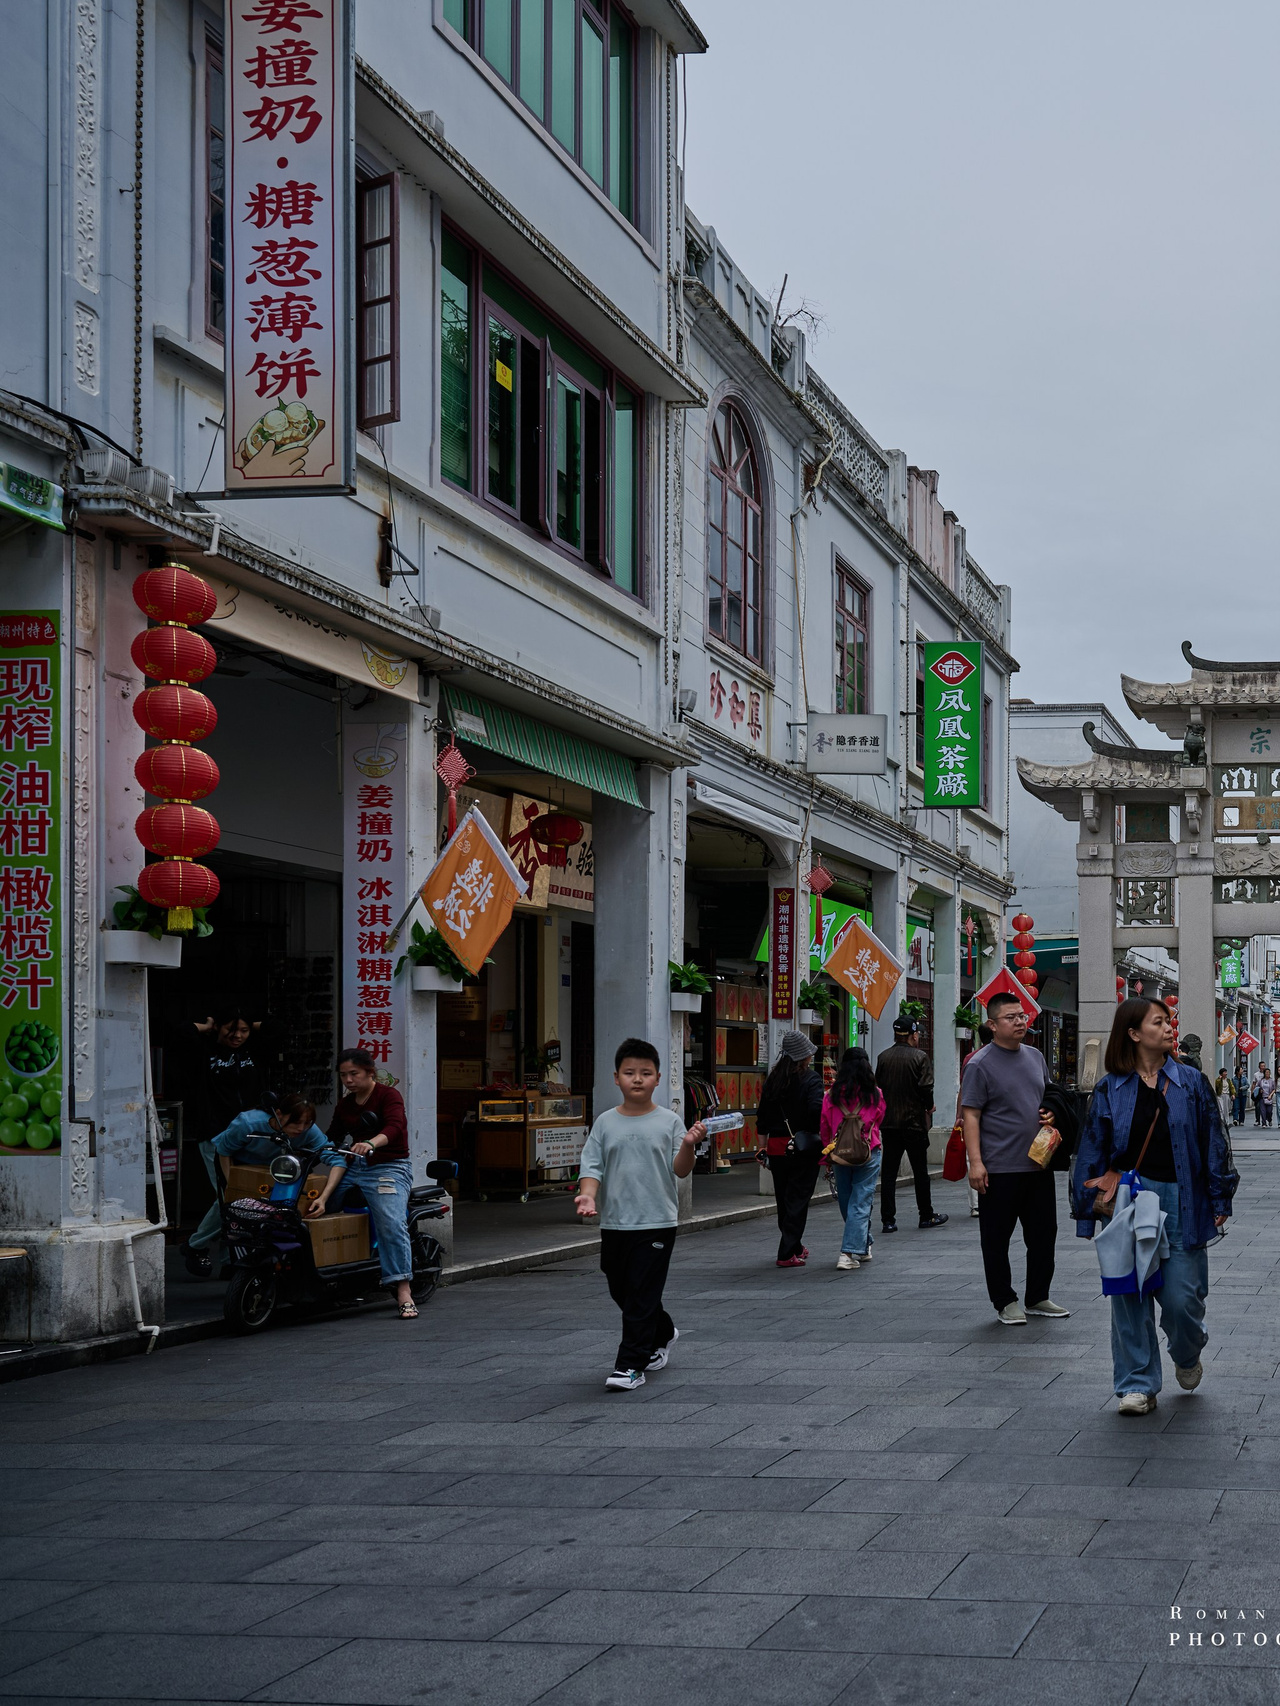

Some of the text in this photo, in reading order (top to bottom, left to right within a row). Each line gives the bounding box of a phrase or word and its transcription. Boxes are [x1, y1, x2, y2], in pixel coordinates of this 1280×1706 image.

[836, 735, 880, 747] 隐香香道
[0, 657, 53, 1010] 现榨 油柑 橄榄汁
[357, 784, 393, 863] 姜撞奶
